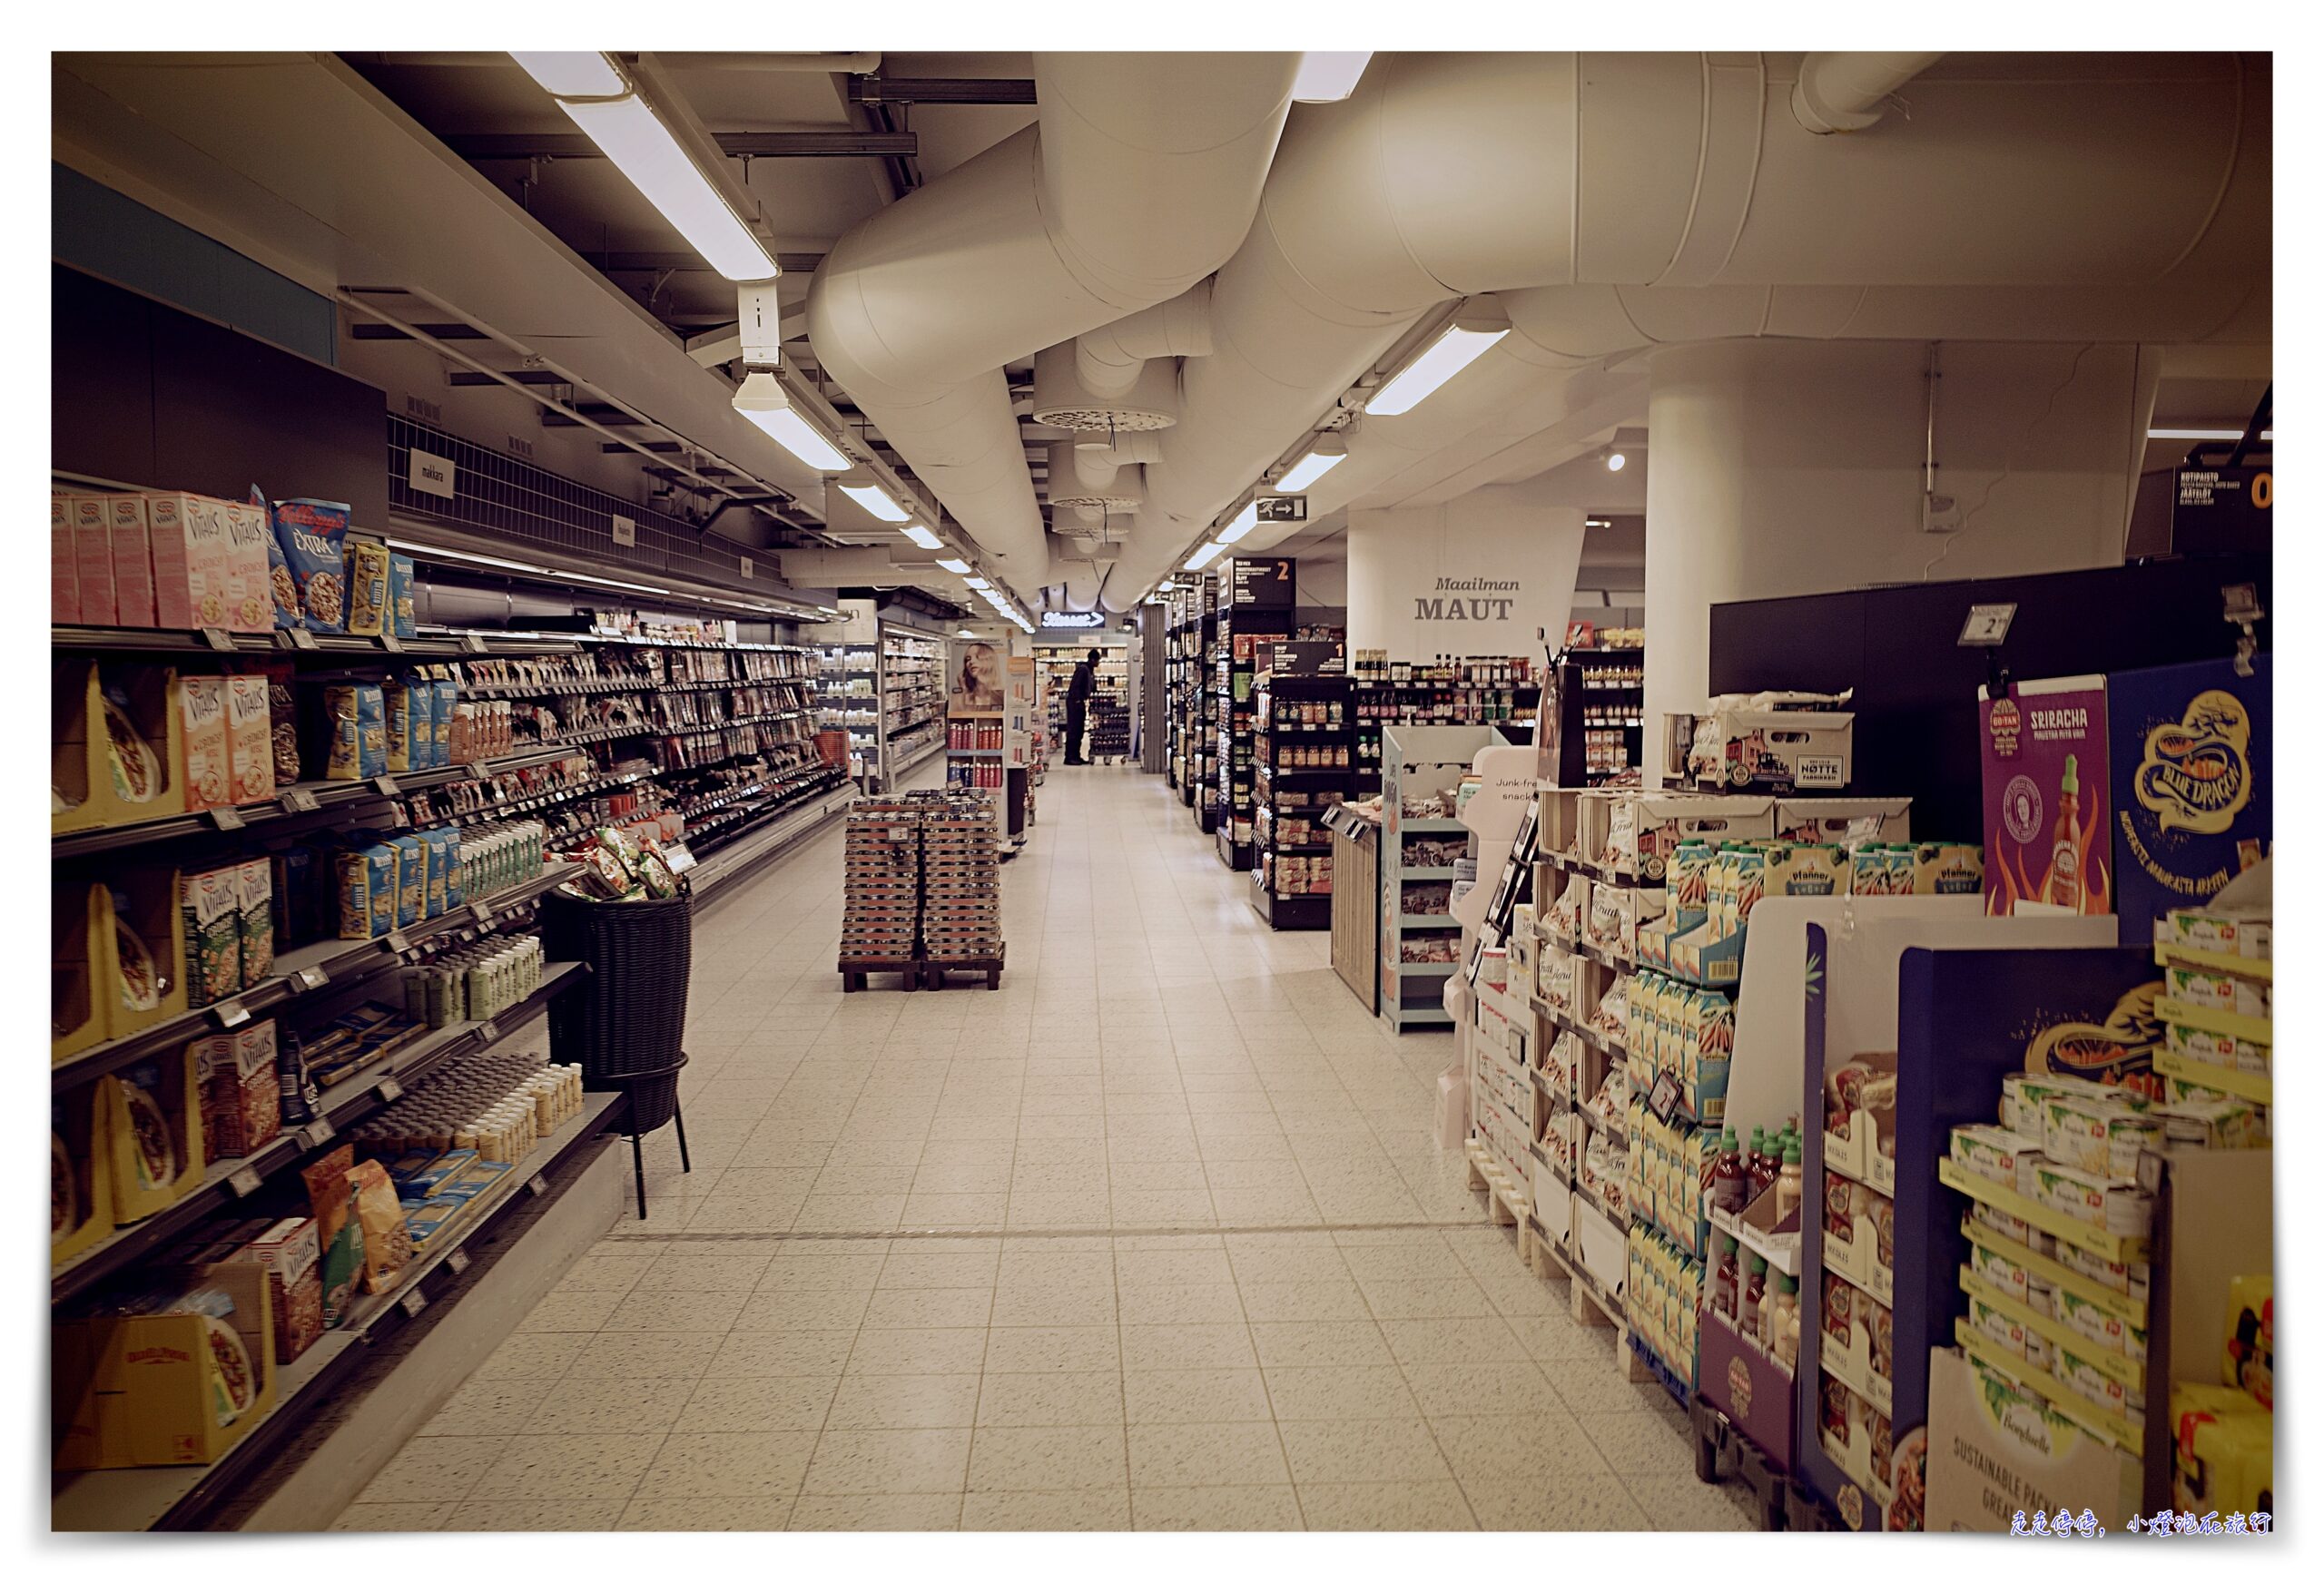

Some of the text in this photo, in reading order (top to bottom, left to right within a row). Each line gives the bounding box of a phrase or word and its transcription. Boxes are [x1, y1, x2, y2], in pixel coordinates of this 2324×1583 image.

[293, 527, 334, 556] EXTRA
[1277, 561, 1289, 580] 2
[1435, 577, 1520, 591] Maailman
[1414, 598, 1513, 621] MAUT
[1335, 648, 1344, 658] 1
[2031, 708, 2087, 730] SRIRACHA
[1496, 778, 1537, 787] Junk-fre
[2163, 762, 2241, 810] BLUE DRAGON
[1954, 1434, 2059, 1520] SUSTAINABLE PACKA
